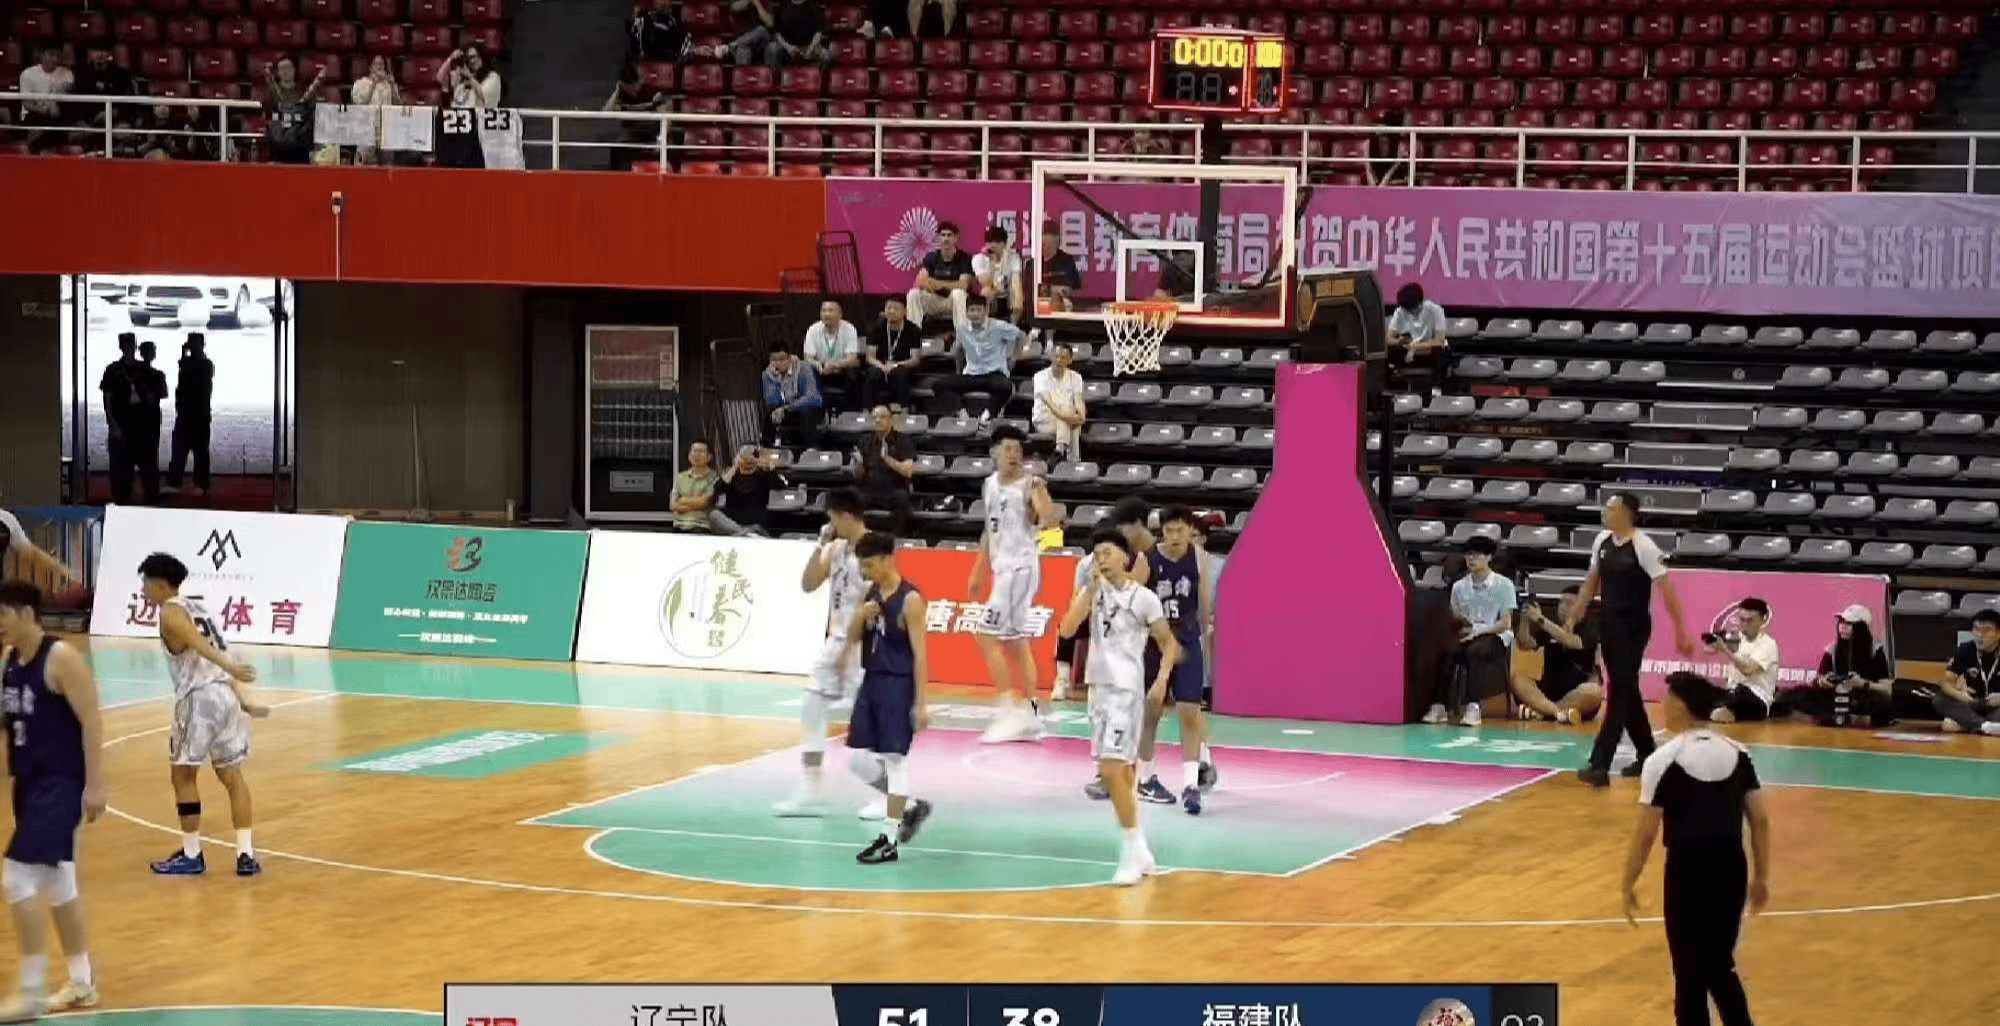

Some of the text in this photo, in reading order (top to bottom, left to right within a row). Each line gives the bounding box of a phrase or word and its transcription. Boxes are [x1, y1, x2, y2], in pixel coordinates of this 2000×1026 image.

[443, 110, 472, 134] 23
[485, 109, 510, 130] 23
[126, 592, 302, 636] 迈体育
[1113, 729, 1124, 747] 7
